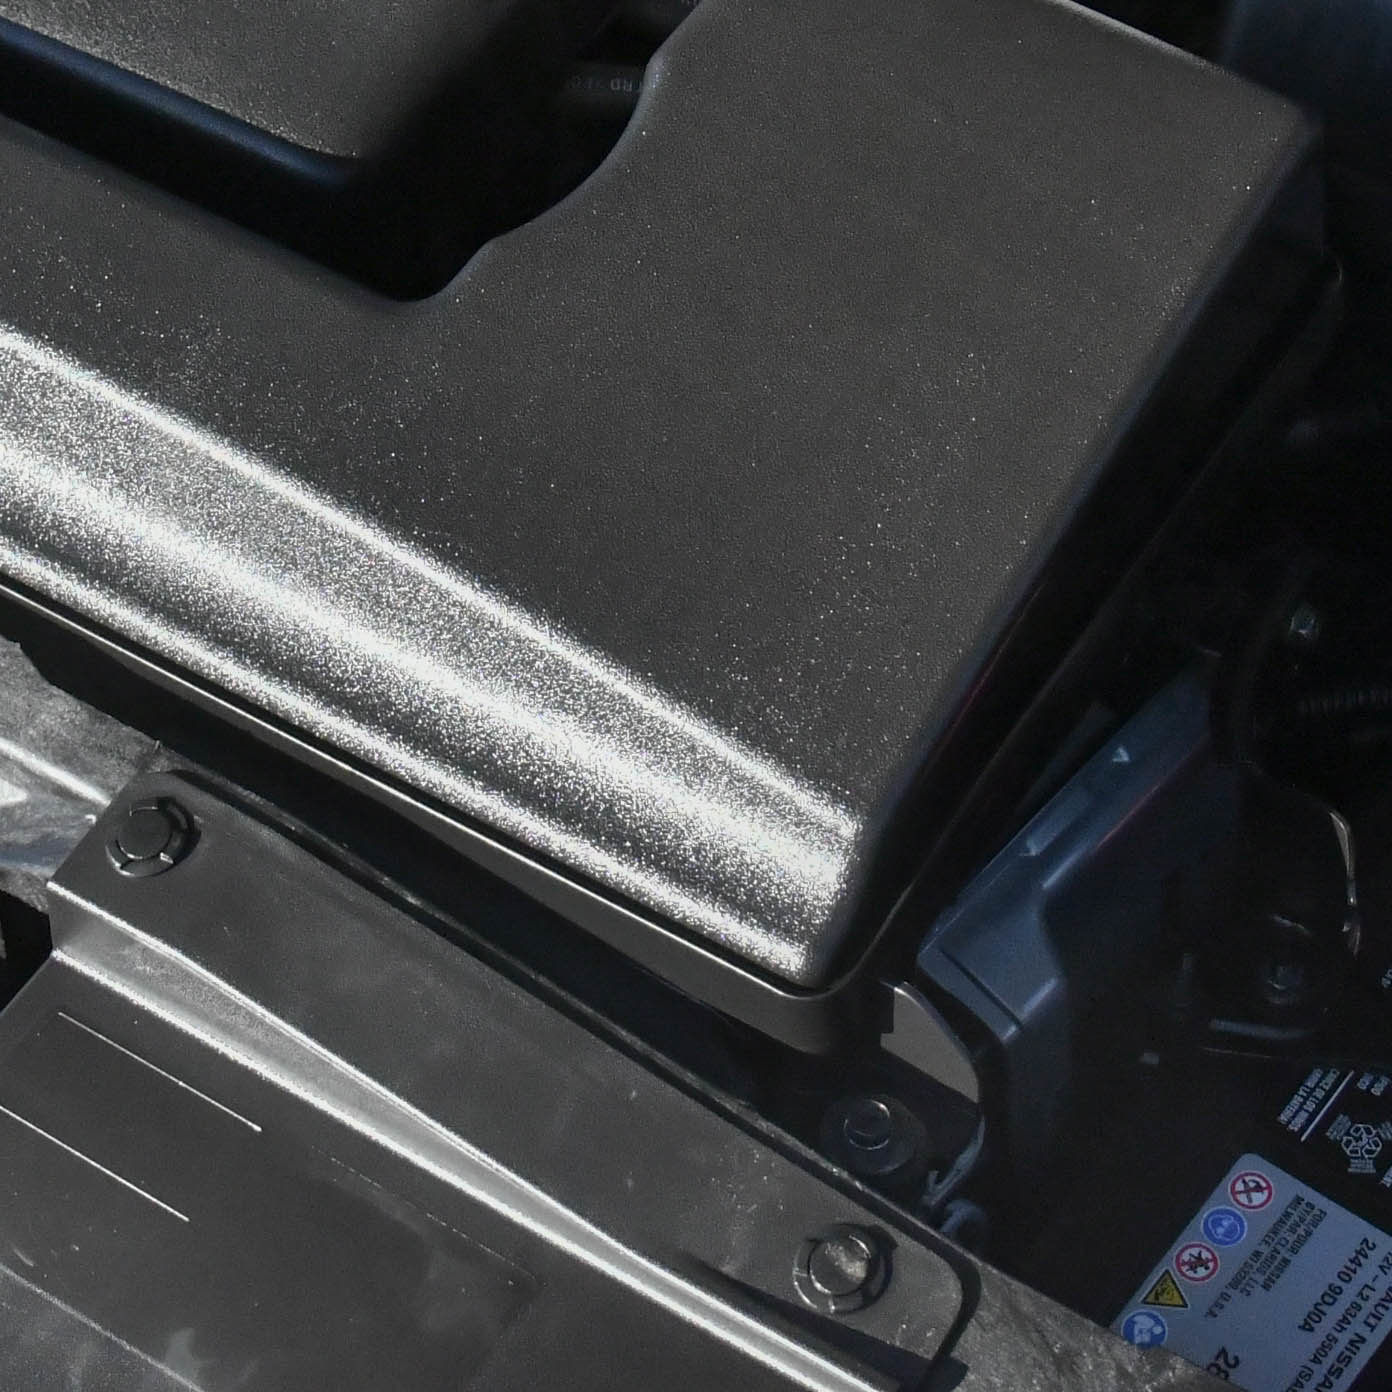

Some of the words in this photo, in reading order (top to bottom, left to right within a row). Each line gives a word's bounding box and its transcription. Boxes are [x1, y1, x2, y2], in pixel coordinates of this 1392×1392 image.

[1260, 1256, 1290, 1291] NISSAN
[1337, 1237, 1376, 1283] 24410
[1298, 1283, 1342, 1332] 9DJ0A
[1356, 1283, 1375, 1301] L2
[1309, 1333, 1337, 1364] 550A
[1313, 1332, 1367, 1392] NISSA
